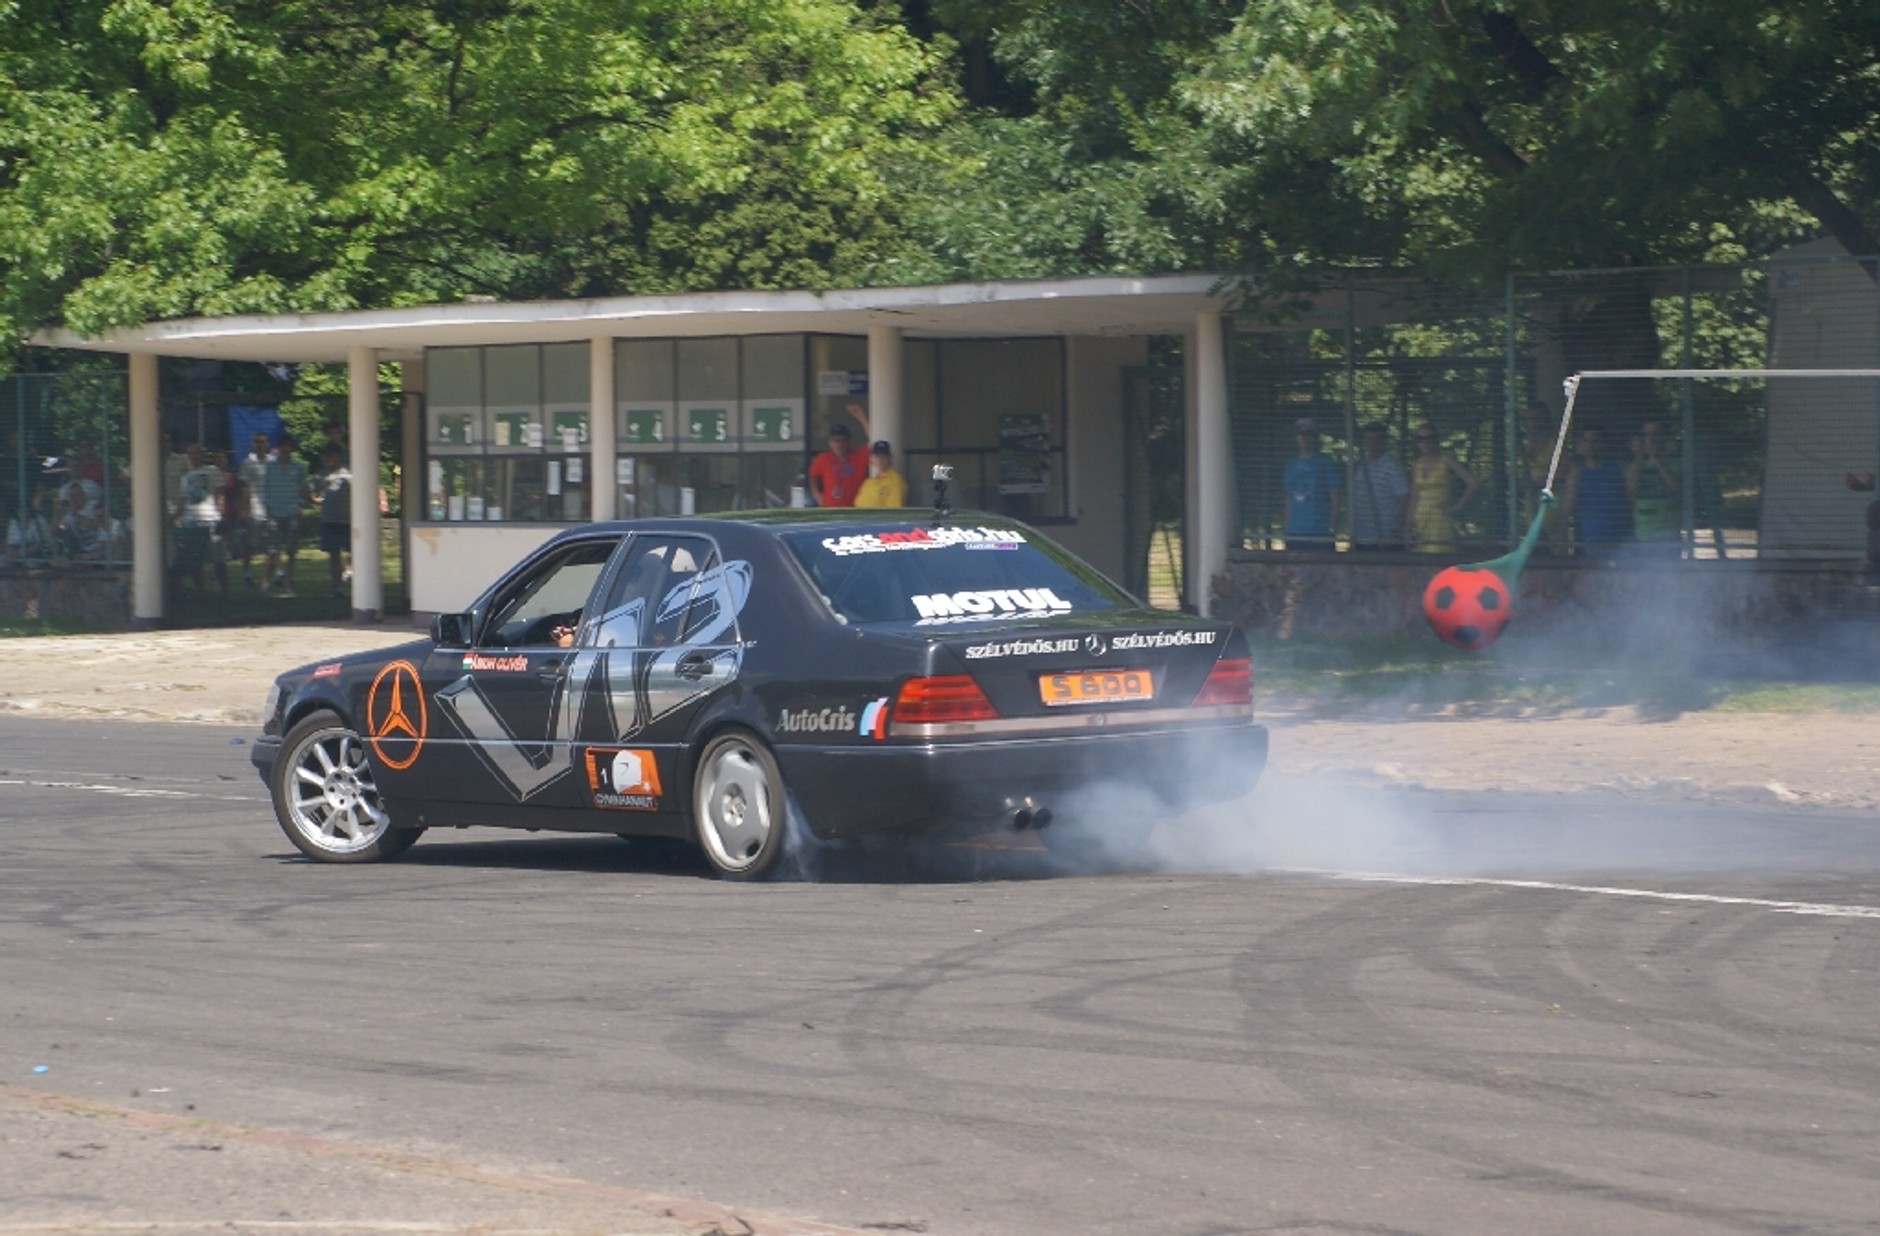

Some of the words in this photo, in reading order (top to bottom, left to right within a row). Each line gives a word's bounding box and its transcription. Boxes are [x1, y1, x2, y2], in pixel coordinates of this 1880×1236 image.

[653, 420, 663, 442] 4
[716, 420, 726, 441] 5
[779, 419, 791, 441] 6
[911, 588, 1072, 619] MOTUL
[1052, 674, 1072, 698] S
[1080, 673, 1142, 696] 600
[775, 705, 856, 732] AutoCris
